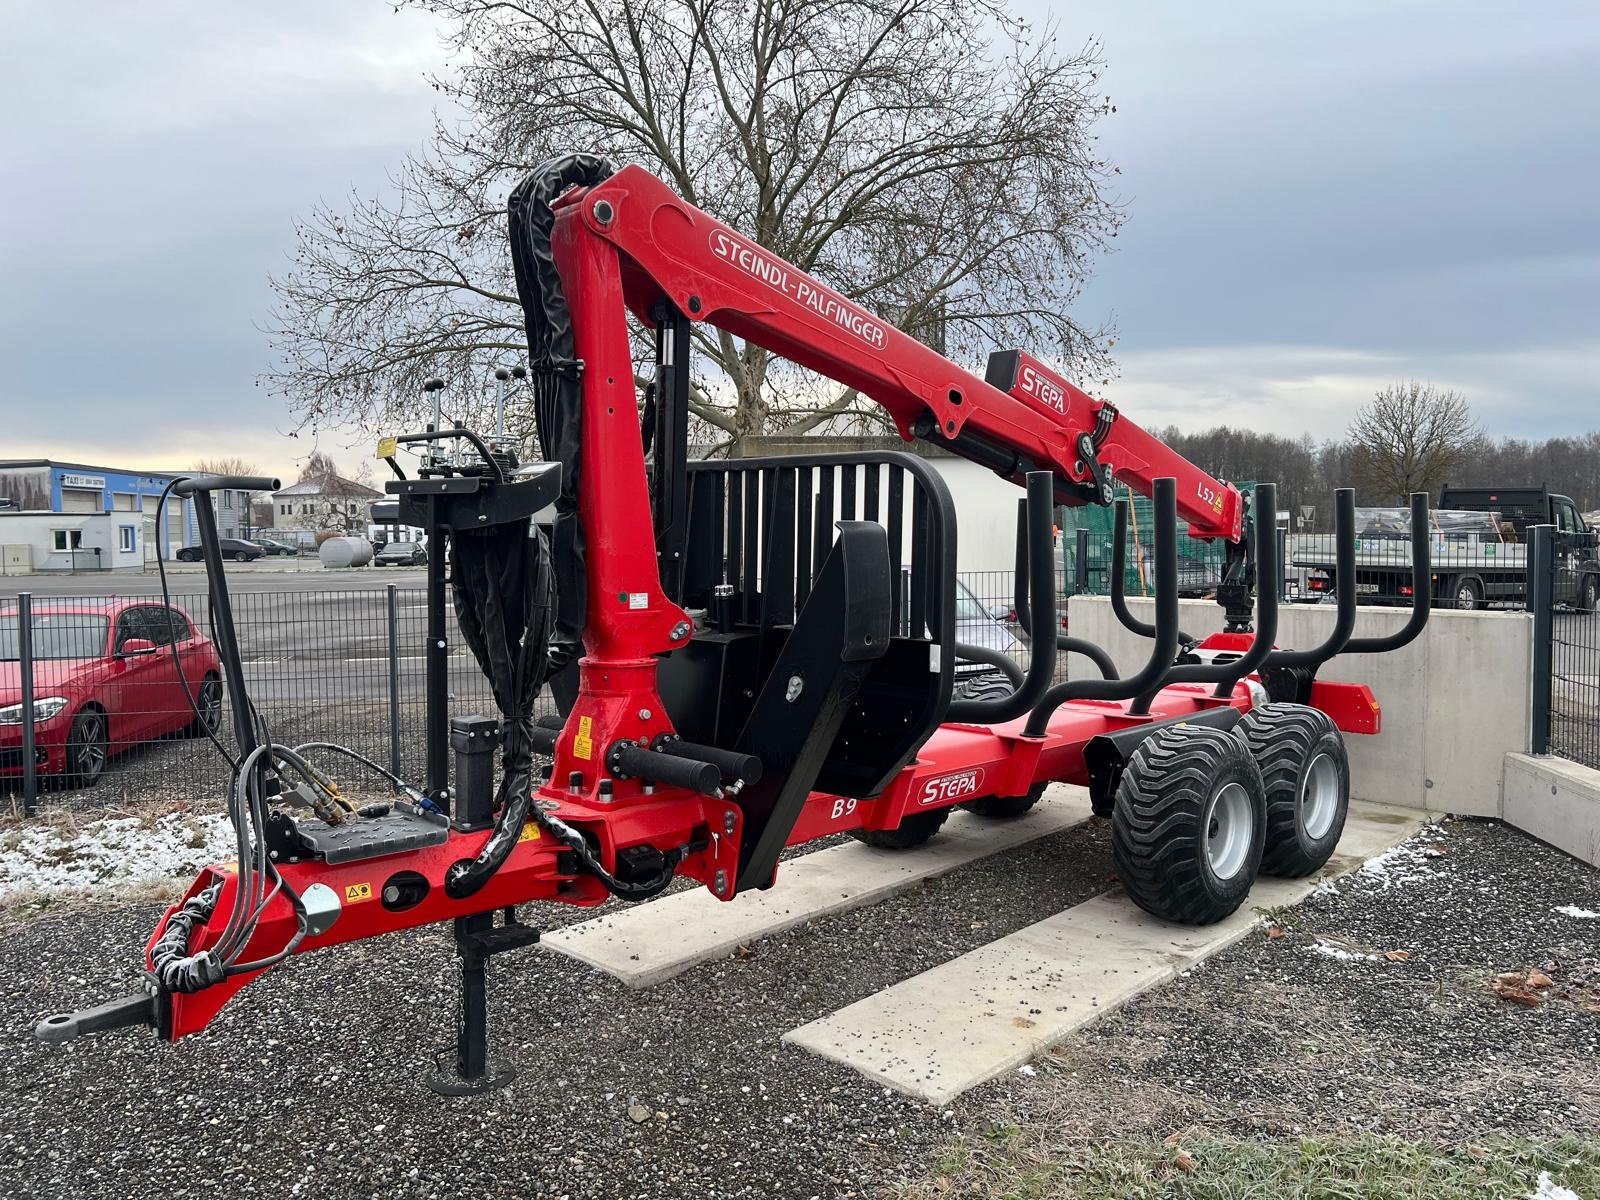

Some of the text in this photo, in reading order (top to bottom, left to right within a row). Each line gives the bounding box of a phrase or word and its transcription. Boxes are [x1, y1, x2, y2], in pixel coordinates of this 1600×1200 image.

[715, 234, 883, 346] STEINDL-PALFINGER
[1022, 367, 1064, 413] STEPA
[66, 476, 79, 485] TAXI
[1197, 482, 1213, 505] L52
[922, 776, 976, 804] STEPA
